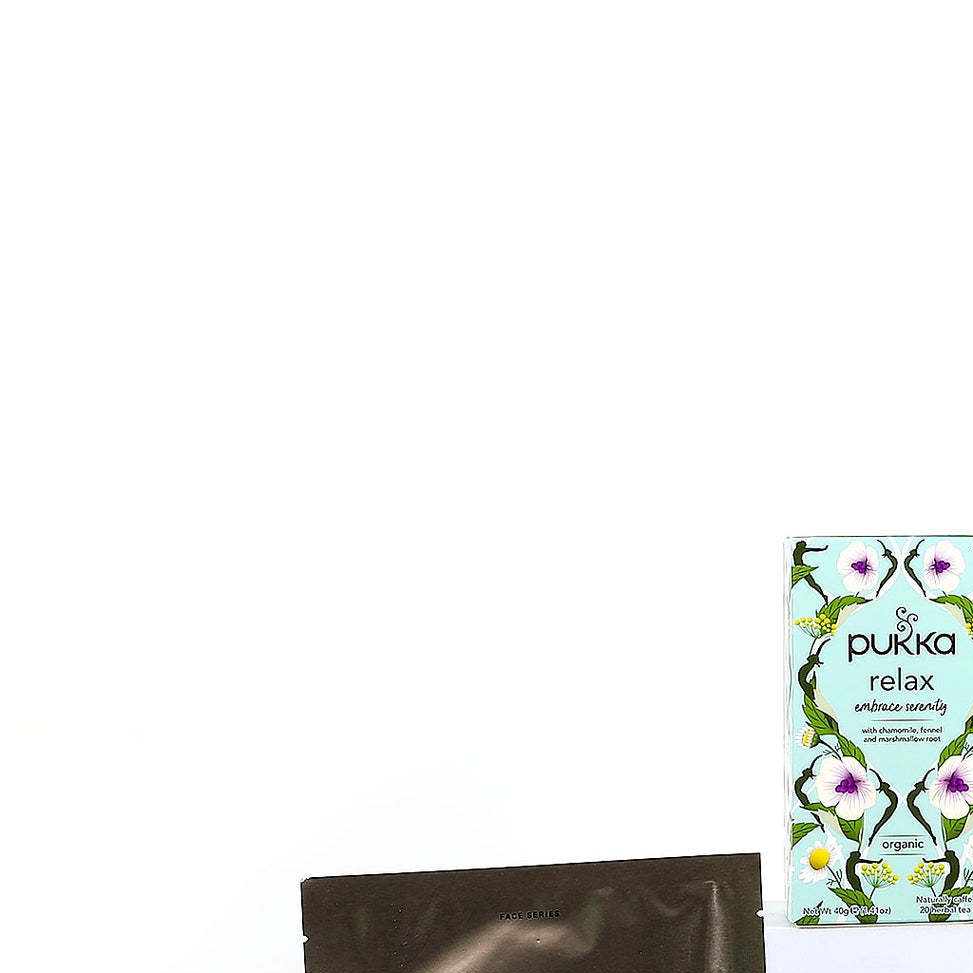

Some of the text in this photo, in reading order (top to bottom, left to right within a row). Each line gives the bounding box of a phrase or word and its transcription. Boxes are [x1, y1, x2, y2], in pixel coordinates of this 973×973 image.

[848, 614, 956, 663] pukka
[869, 666, 935, 691] relax
[854, 698, 948, 717] embrace serenity
[861, 726, 878, 735] with
[920, 726, 943, 735] fennel
[863, 735, 941, 743] and marshmallow root
[882, 838, 925, 852] organic
[916, 895, 951, 905] Naturally
[499, 909, 561, 921] FACE SERIES
[802, 907, 818, 915] Net
[819, 907, 832, 915] Wt
[919, 905, 930, 914] 20
[930, 905, 957, 914] herbal
[958, 906, 971, 914] tea
